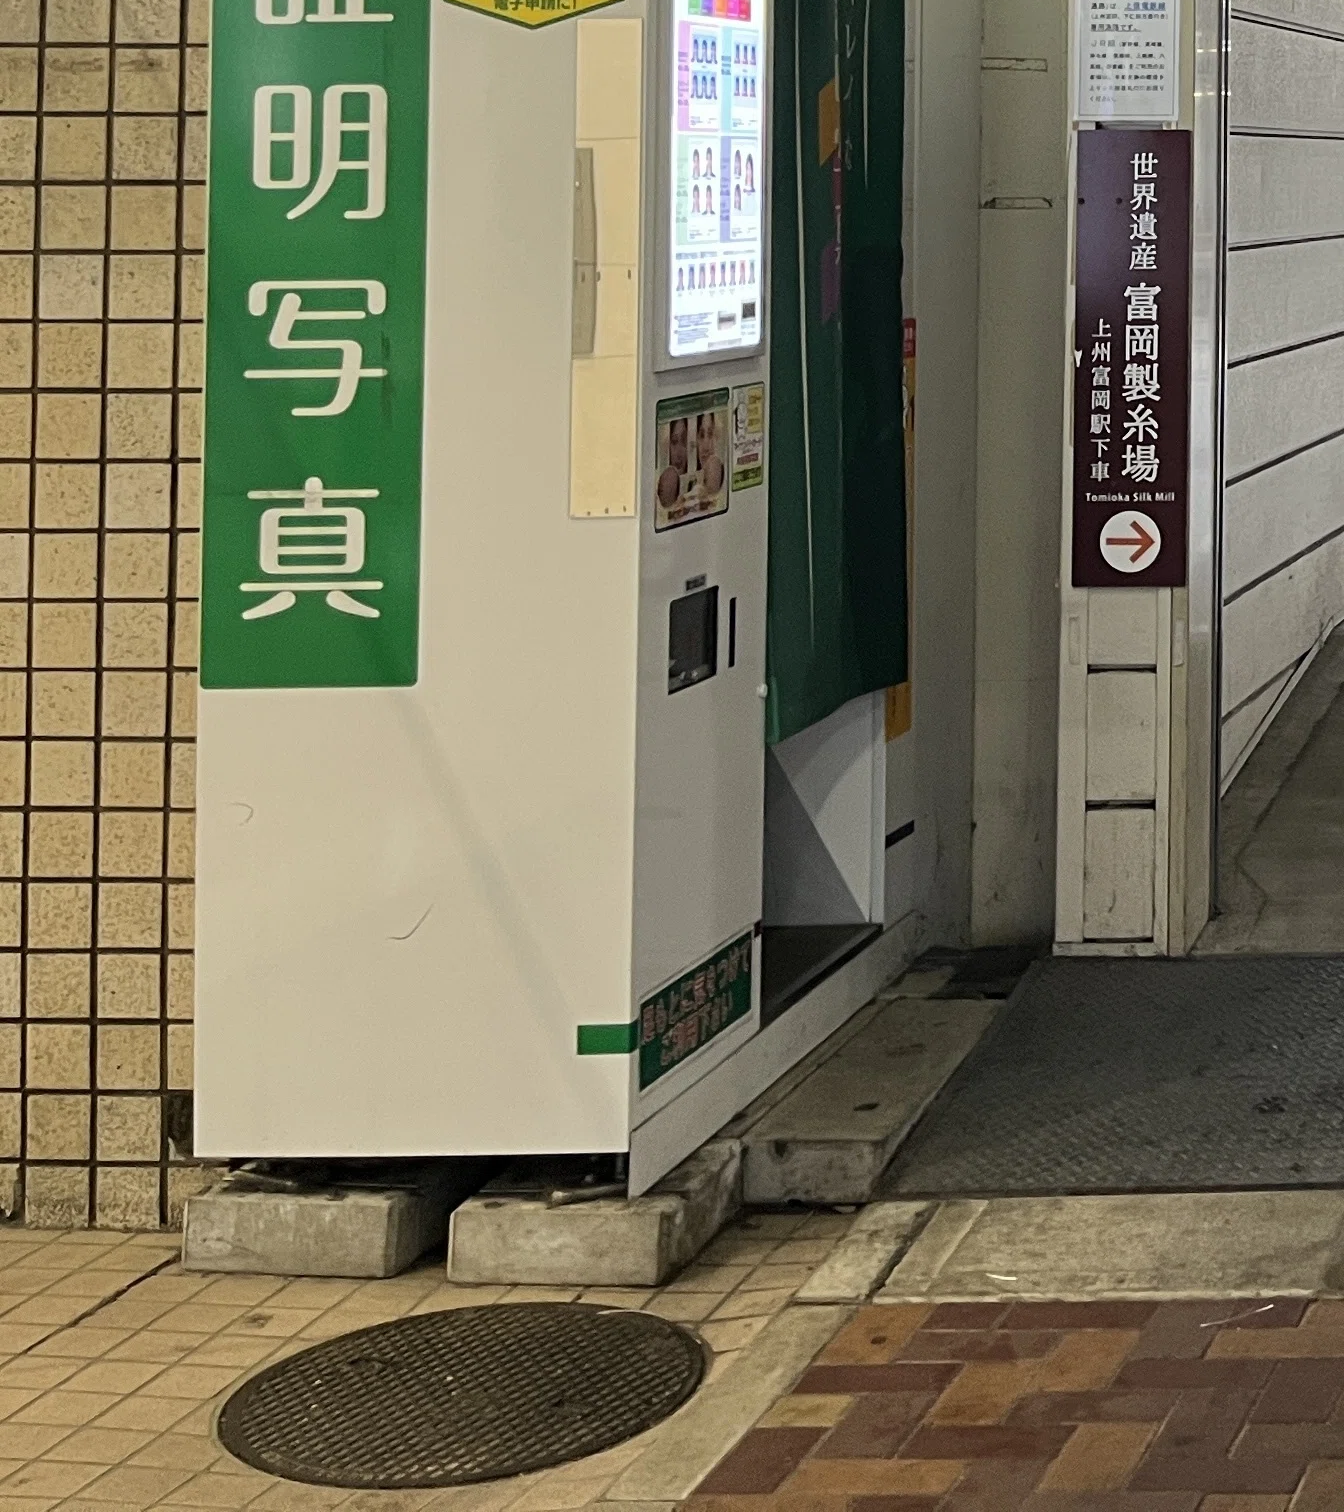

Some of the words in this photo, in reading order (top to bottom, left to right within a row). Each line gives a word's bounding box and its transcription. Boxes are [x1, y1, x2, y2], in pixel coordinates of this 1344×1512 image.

[1128, 152, 1159, 270] 世界遺産
[1090, 318, 1112, 482] 上州富岡駅下車
[1121, 282, 1162, 484] 富岡製糸場
[1085, 492, 1130, 502] Tomioka
[1132, 492, 1152, 502] Silk
[1155, 492, 1175, 502] Mill
